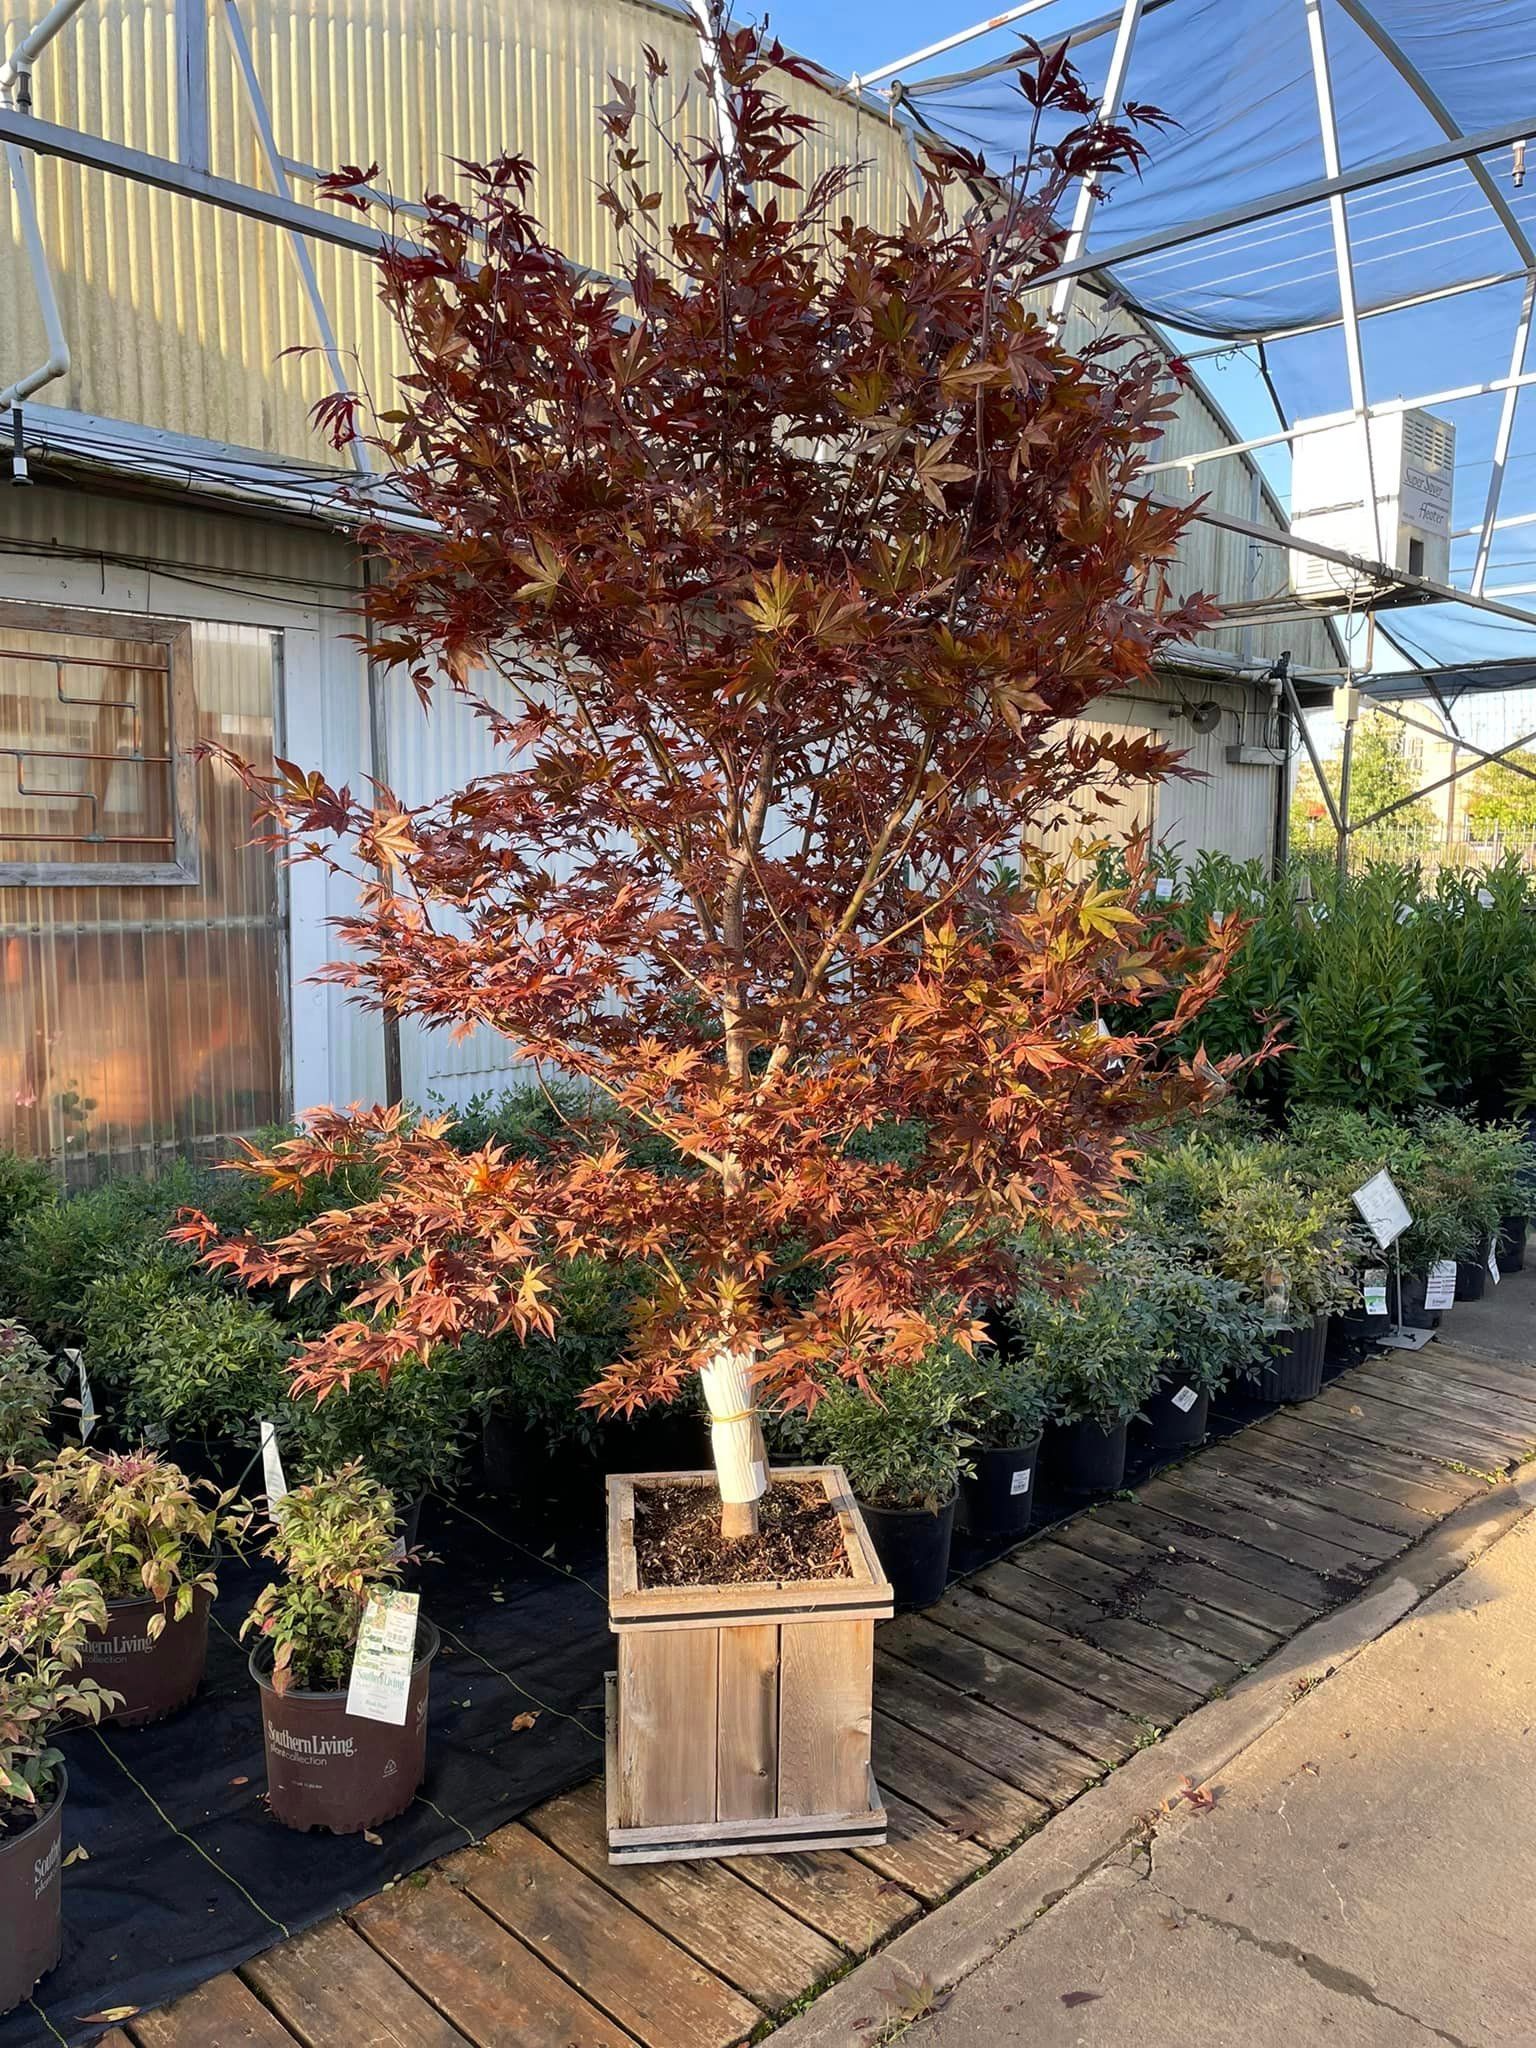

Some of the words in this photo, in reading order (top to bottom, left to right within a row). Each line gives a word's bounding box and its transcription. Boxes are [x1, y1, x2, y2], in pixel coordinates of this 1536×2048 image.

[1404, 468, 1425, 488] Super
[1419, 502, 1444, 524] Heater
[267, 1720, 312, 1752] Southern
